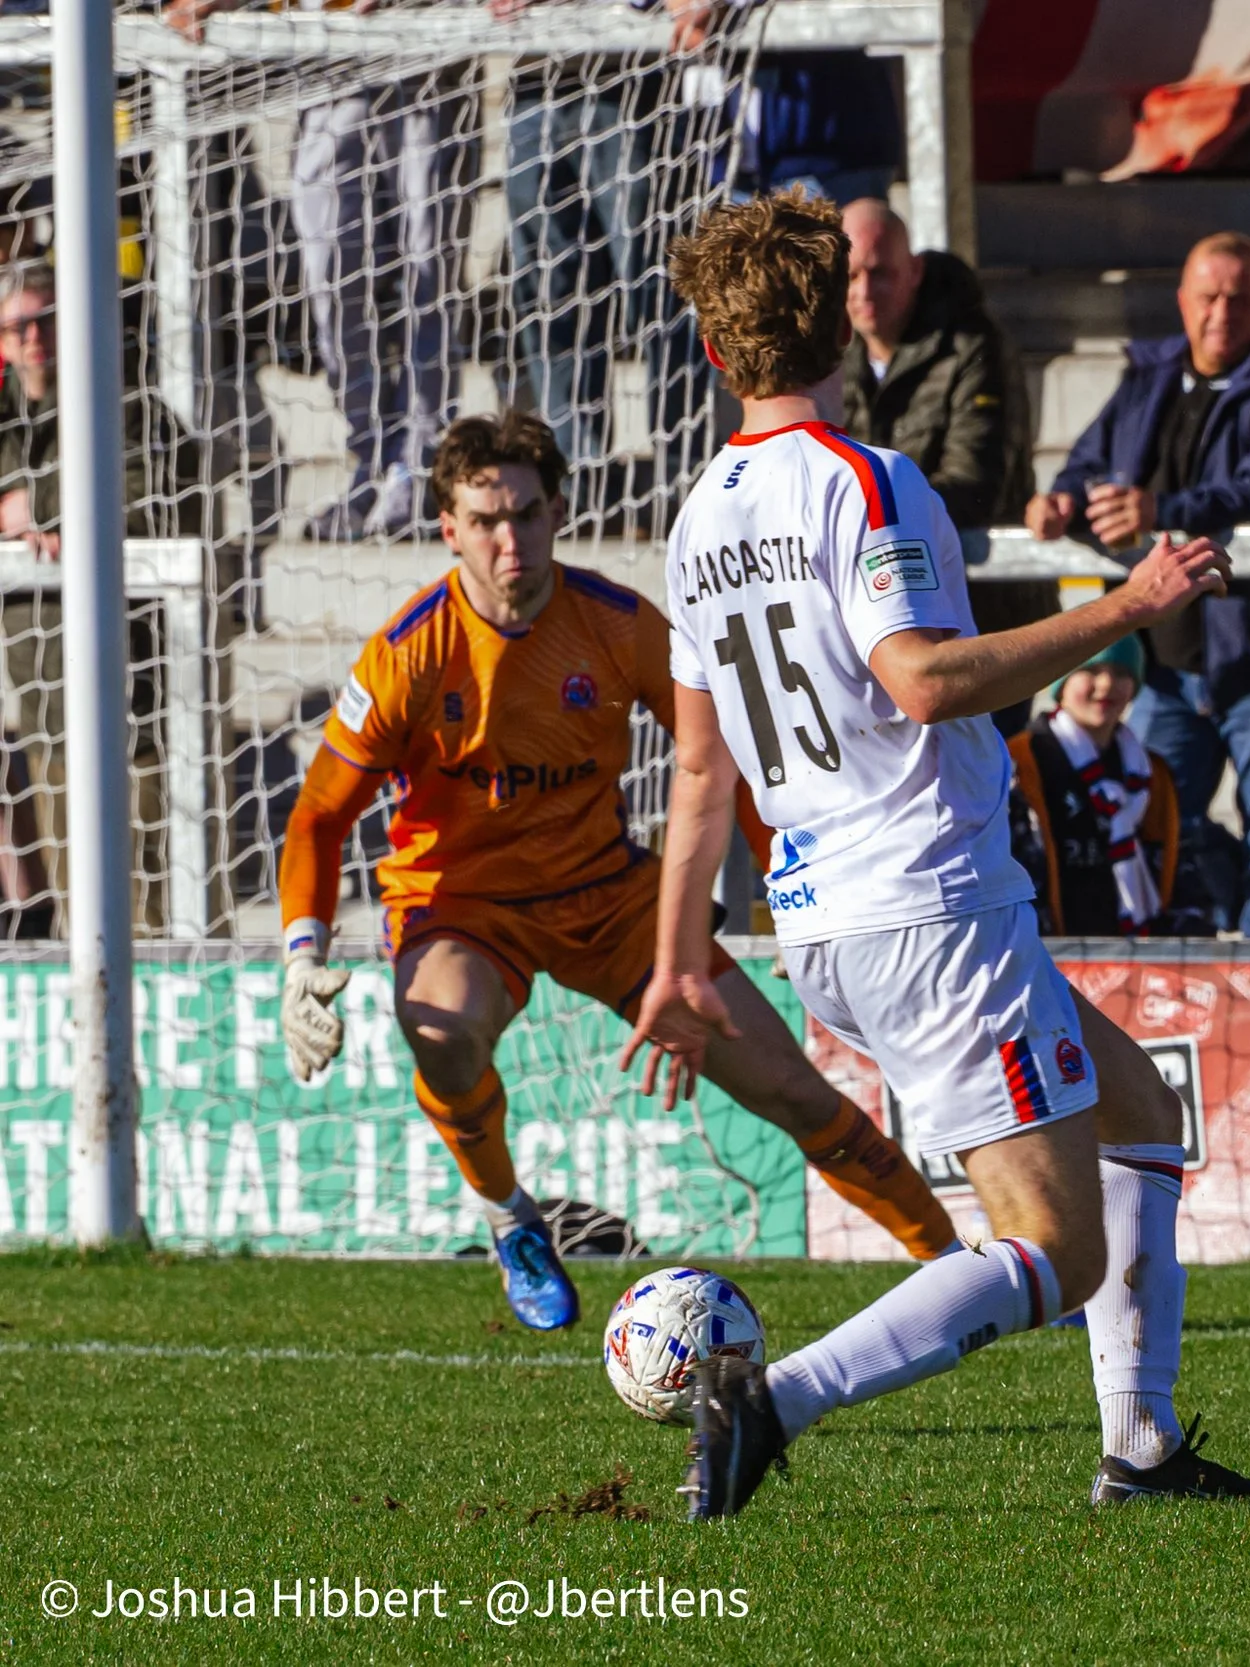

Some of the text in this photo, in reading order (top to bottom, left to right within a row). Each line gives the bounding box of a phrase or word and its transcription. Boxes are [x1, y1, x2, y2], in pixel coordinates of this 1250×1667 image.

[714, 601, 841, 788] 15
[235, 972, 398, 1088] FR
[354, 1120, 682, 1237] LEGUE
